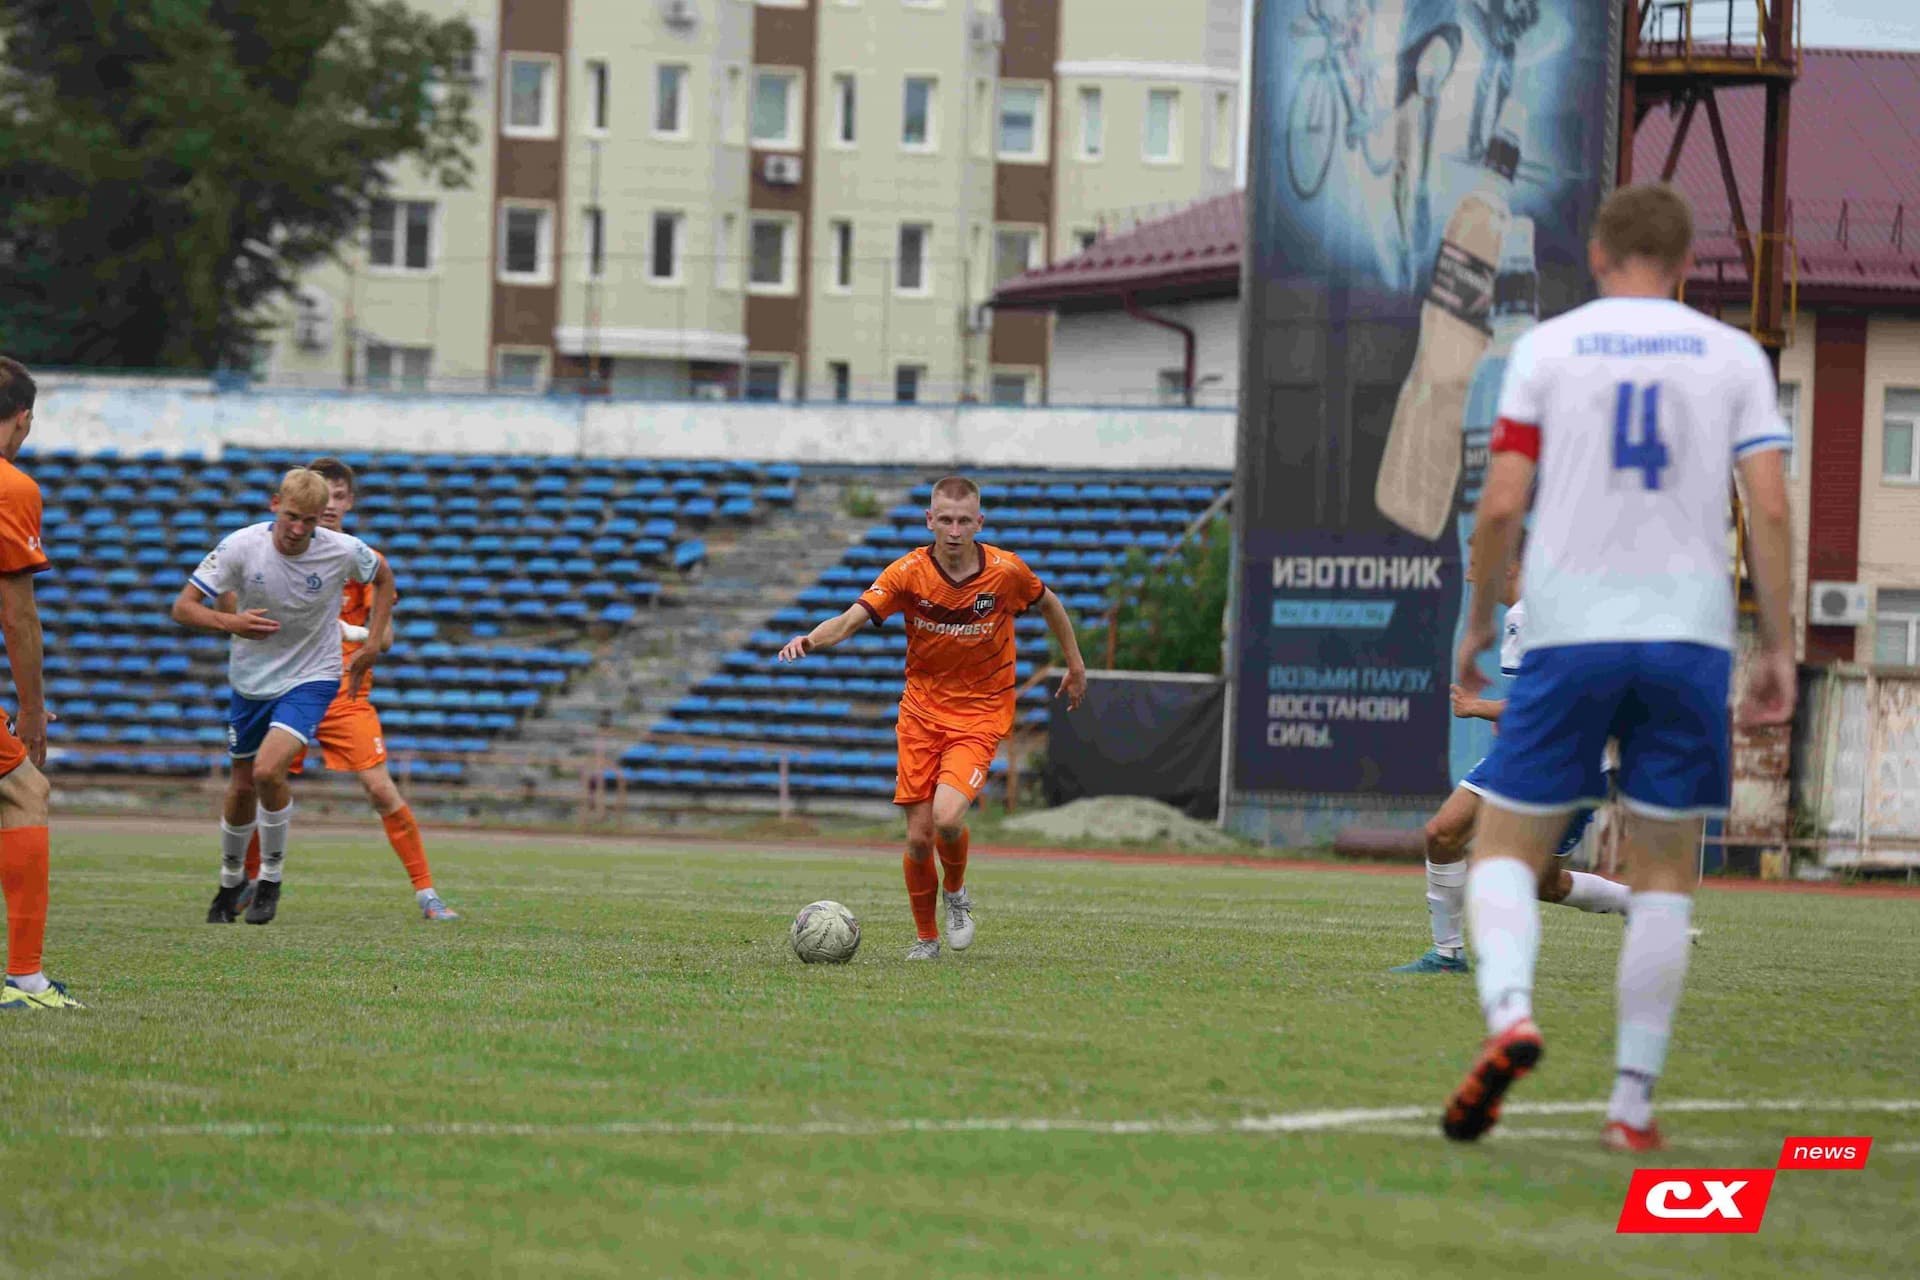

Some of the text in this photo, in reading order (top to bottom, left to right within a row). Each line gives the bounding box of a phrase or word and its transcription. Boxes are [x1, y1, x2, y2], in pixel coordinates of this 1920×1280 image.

[1613, 381, 1669, 490] 4
[1272, 556, 1443, 590] ИЗОТОНИК
[1268, 664, 1358, 690] ВОЗЬМИ
[1267, 694, 1410, 722] ВОССТАНОВИ
